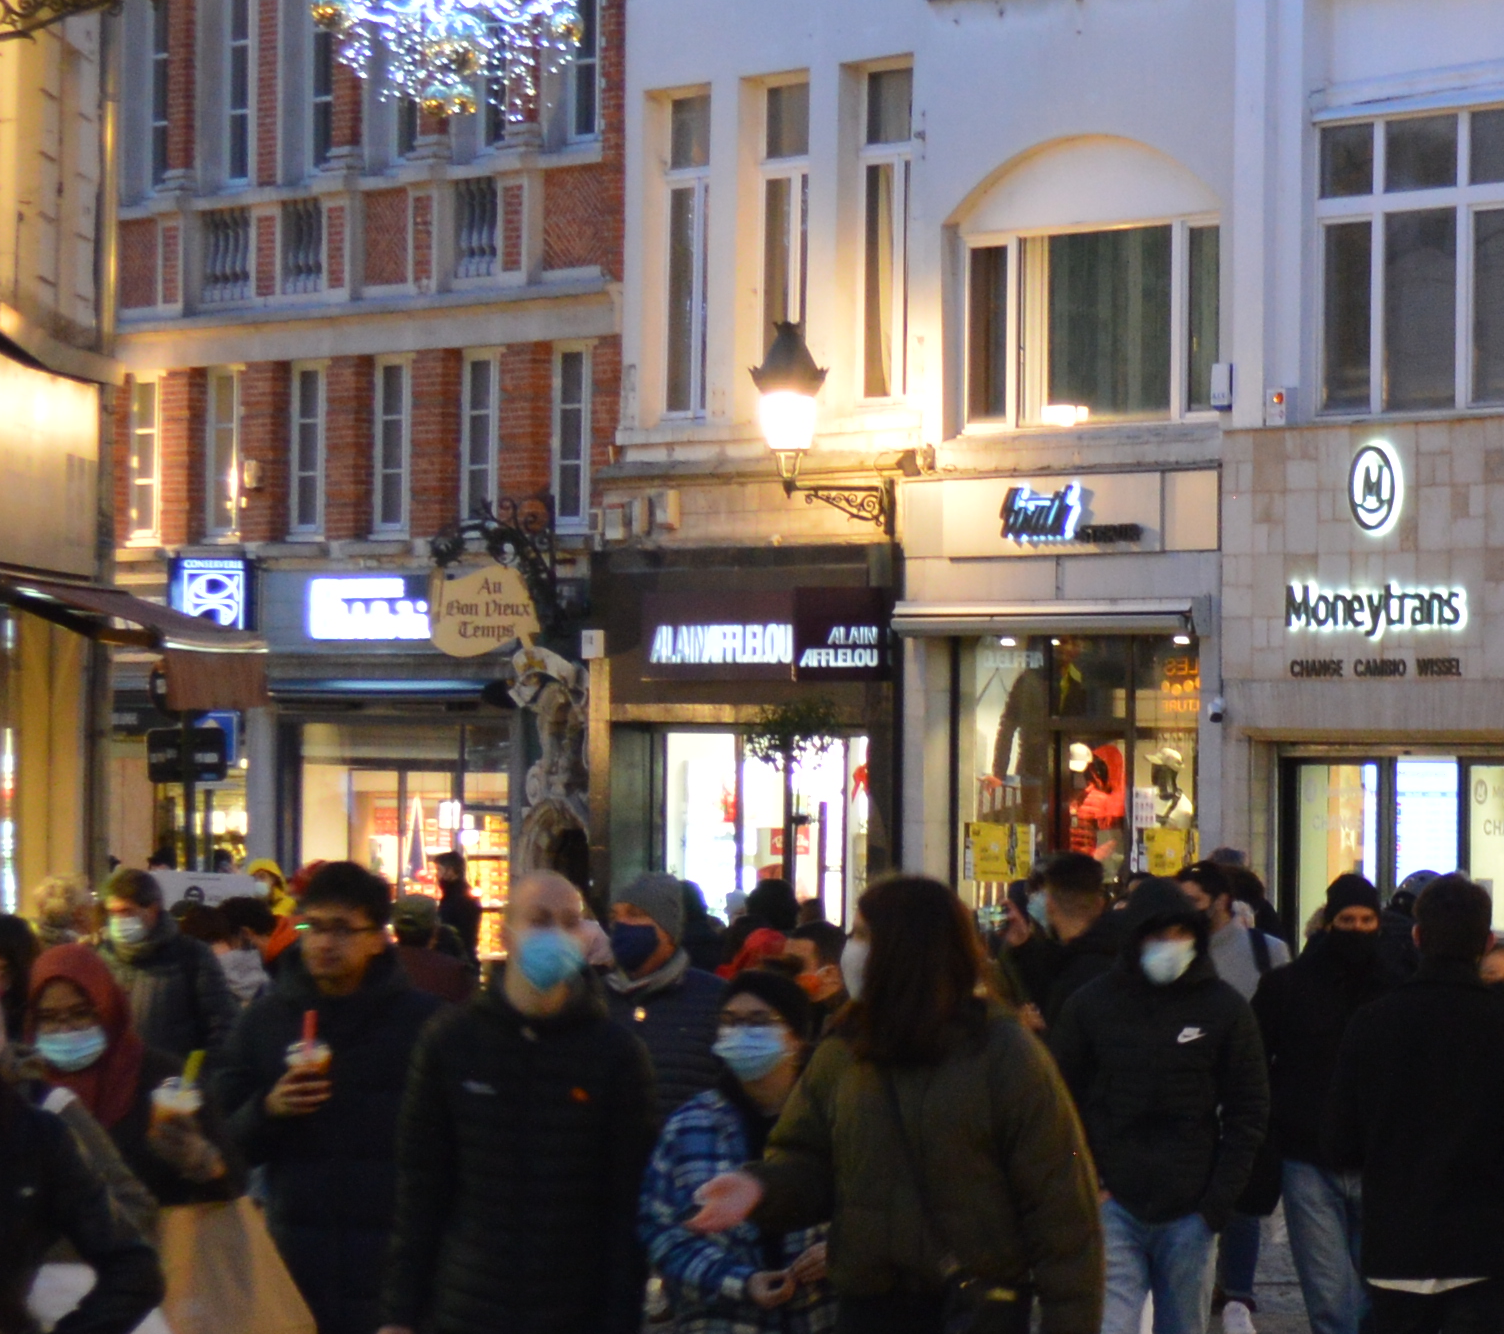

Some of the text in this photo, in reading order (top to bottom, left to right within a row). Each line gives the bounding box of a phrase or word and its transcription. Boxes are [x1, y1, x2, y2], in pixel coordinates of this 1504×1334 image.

[477, 577, 502, 595] Au
[446, 599, 531, 617] Bon Vieux
[1285, 583, 1461, 637] Moneytrans
[458, 621, 515, 642] Temps
[827, 626, 878, 645] ALAIN
[701, 624, 794, 663] AFFLELOU
[799, 648, 878, 668] AFFLELOU
[1290, 658, 1462, 677] CHANGE CAMBIO WISSEL
